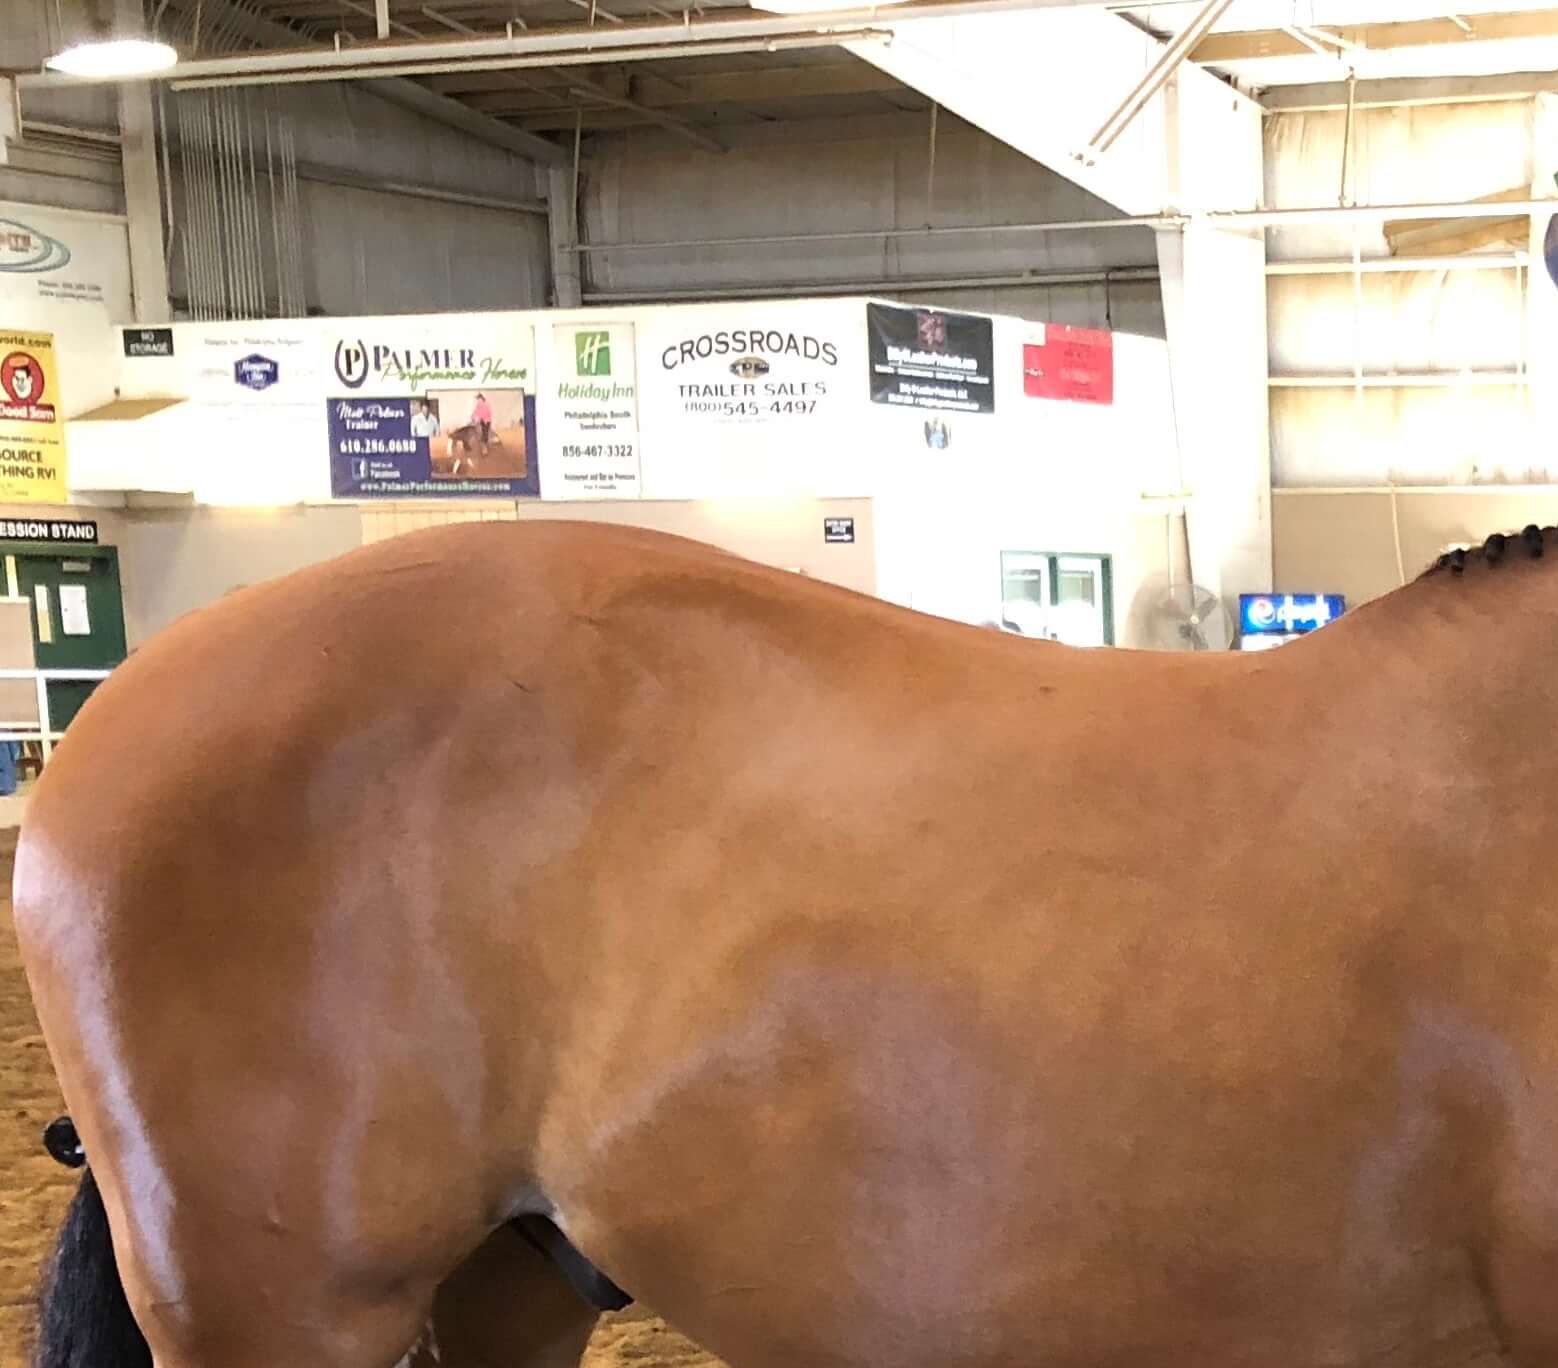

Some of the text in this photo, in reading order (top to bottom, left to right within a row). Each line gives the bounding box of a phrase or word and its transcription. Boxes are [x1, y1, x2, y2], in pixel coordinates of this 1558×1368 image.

[373, 345, 474, 371] PALMER
[662, 330, 838, 370] CROSSROADS
[558, 381, 634, 402] Holiday Inn
[678, 381, 827, 398] TRAILER SALES
[346, 420, 378, 431] Trainer
[562, 444, 633, 457] 856-467-3322
[51, 523, 94, 539] STAND
